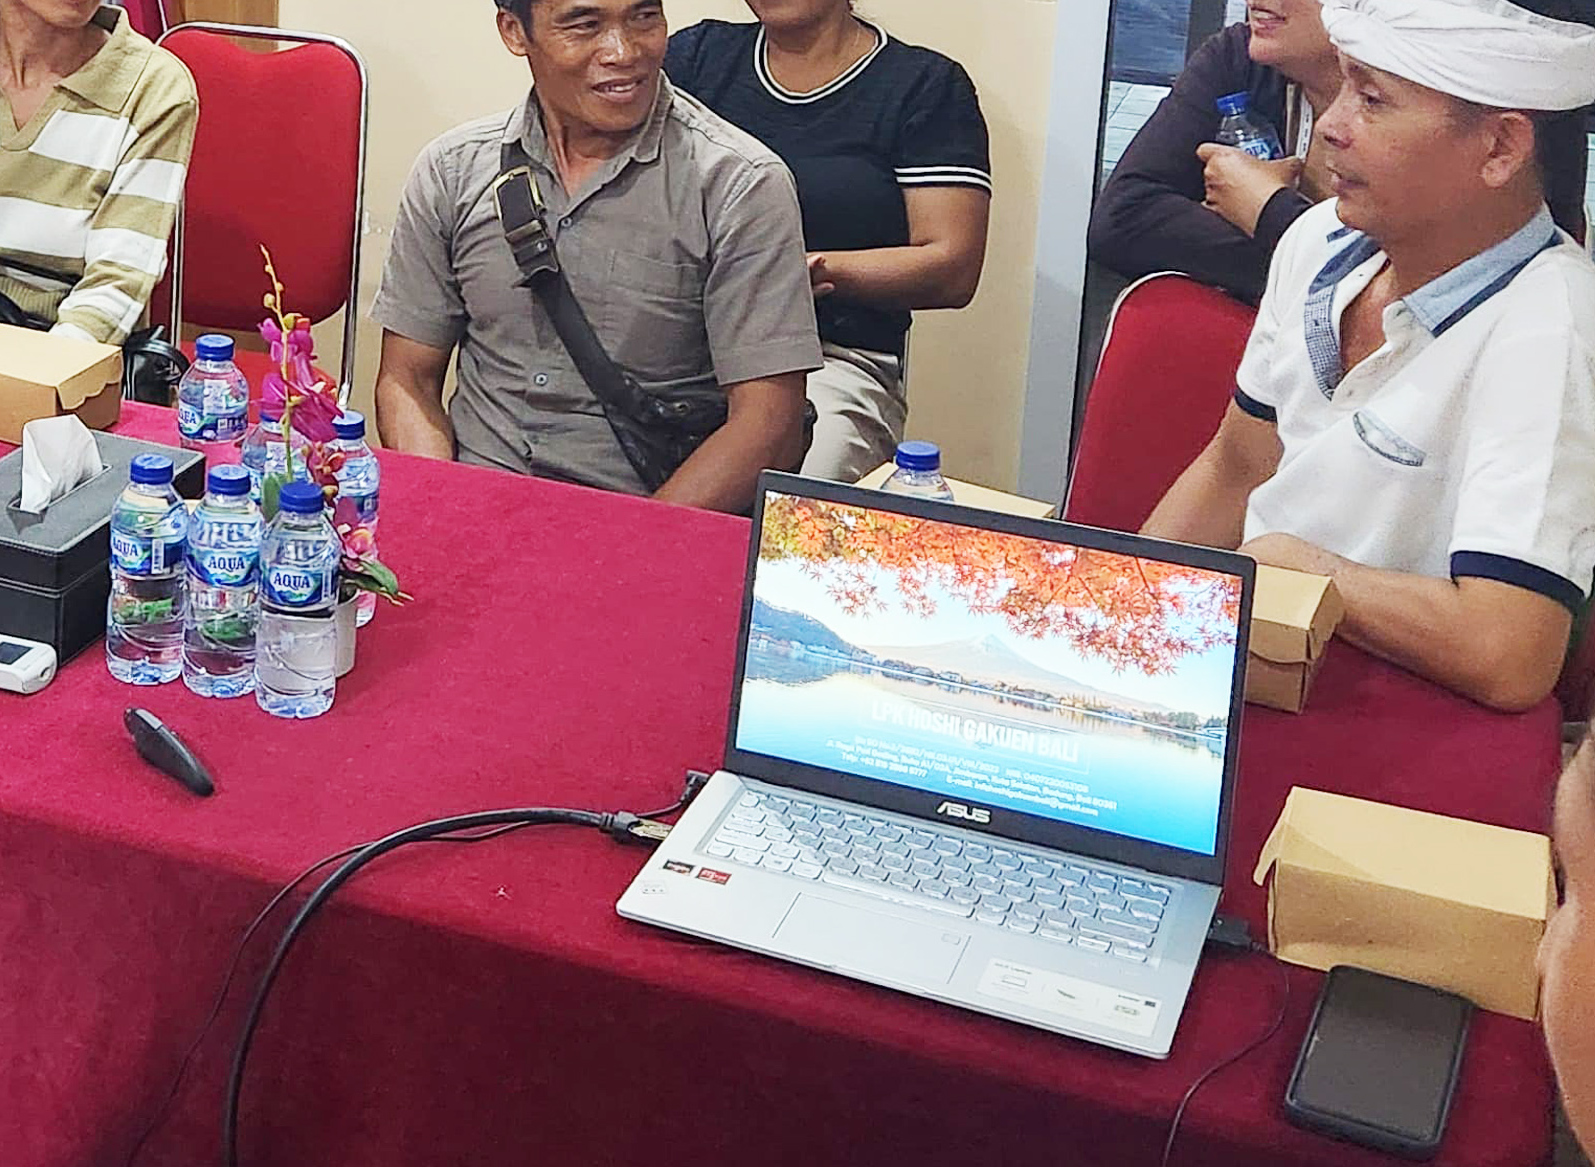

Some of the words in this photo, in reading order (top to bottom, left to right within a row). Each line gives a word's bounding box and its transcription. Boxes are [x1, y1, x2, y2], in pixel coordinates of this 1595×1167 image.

[112, 536, 139, 557] AQUA
[207, 556, 246, 573] AQUA
[273, 572, 311, 590] AQUA
[871, 699, 905, 724] LPK
[907, 705, 962, 737] HOSHI
[962, 717, 1036, 754] GAKUEN
[1037, 733, 1080, 764] BALI
[936, 801, 991, 824] ASUS
